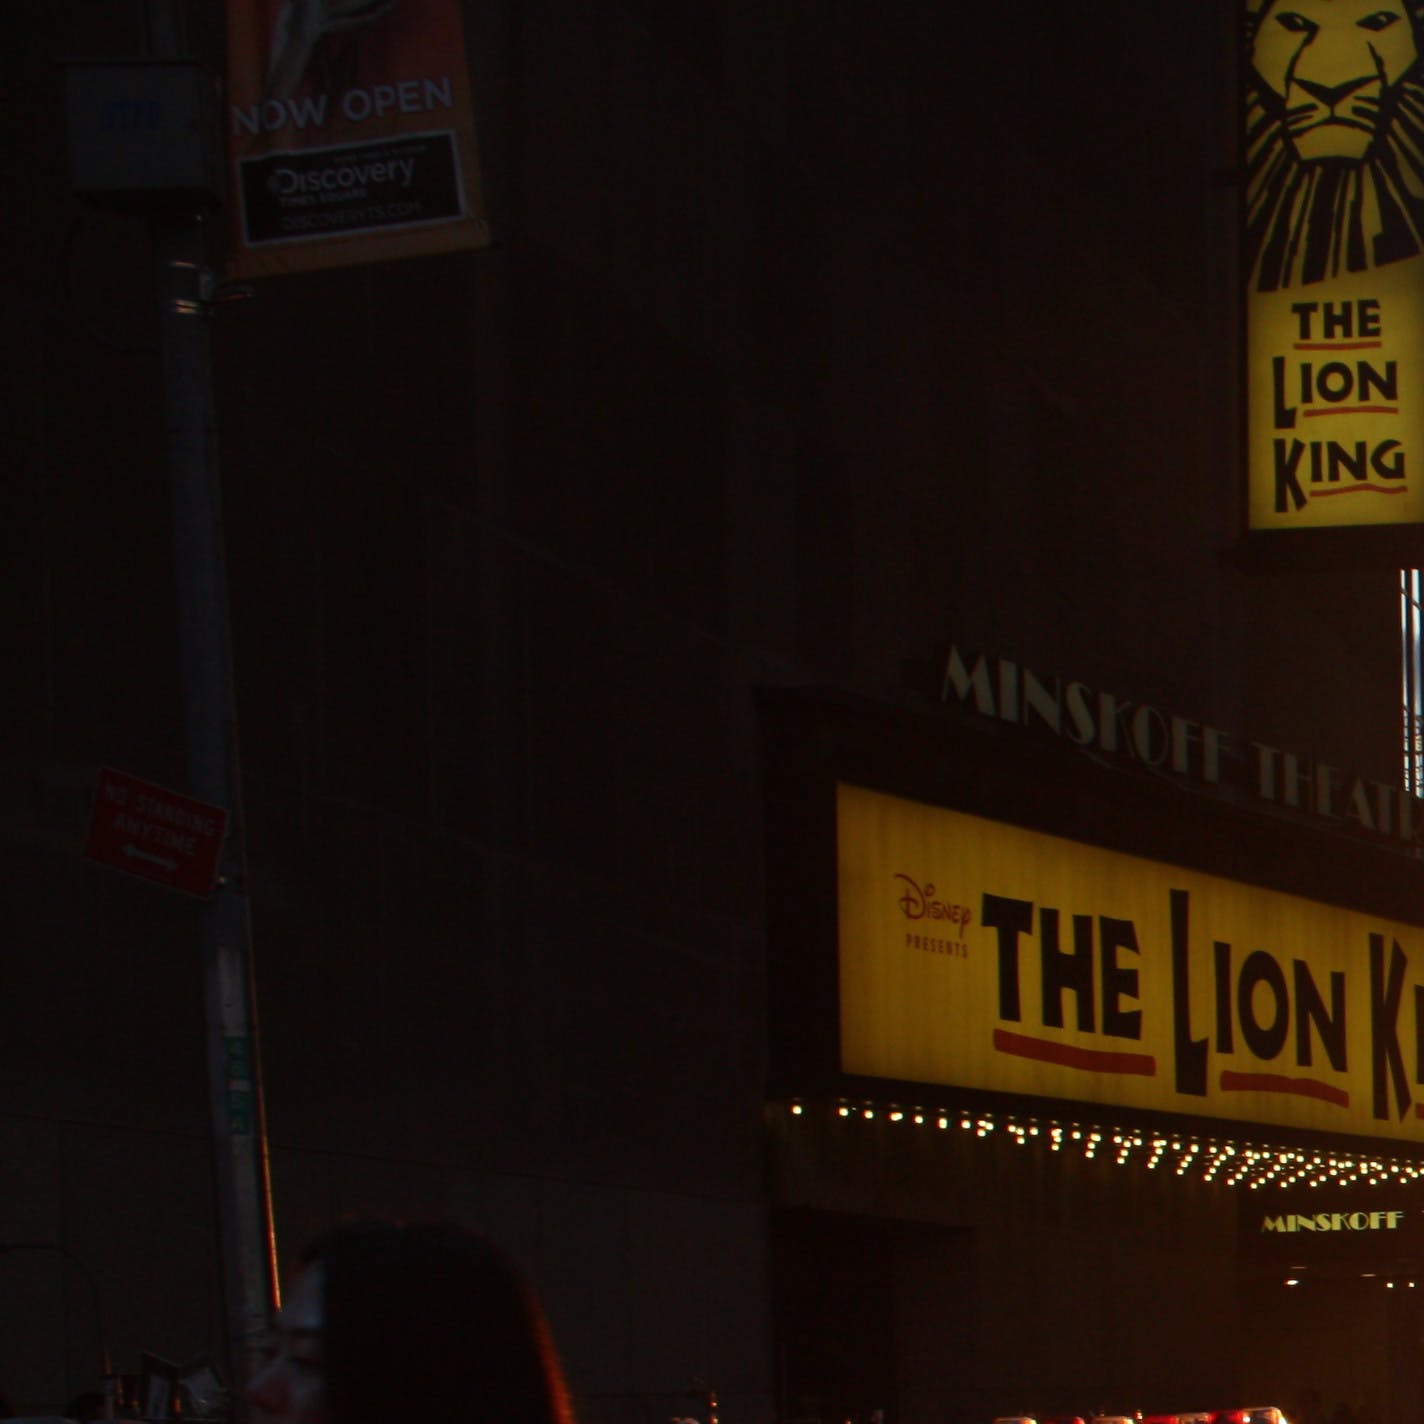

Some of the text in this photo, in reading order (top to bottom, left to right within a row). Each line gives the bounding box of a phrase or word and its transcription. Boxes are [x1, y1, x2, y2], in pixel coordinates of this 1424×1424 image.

[231, 75, 453, 136] NOW OPEN
[270, 157, 416, 194] Discovery
[1292, 299, 1382, 340] THE
[1272, 356, 1399, 429] LION
[1273, 438, 1406, 512] KING
[941, 640, 1233, 784] MINSKOFF
[105, 783, 216, 837] NO STANDING
[111, 811, 197, 857] ANYTIME
[905, 932, 969, 959] PRESENTS
[982, 893, 1143, 1041] THE
[1169, 889, 1349, 1097] LION
[1260, 1210, 1405, 1234] MINSKOFF
